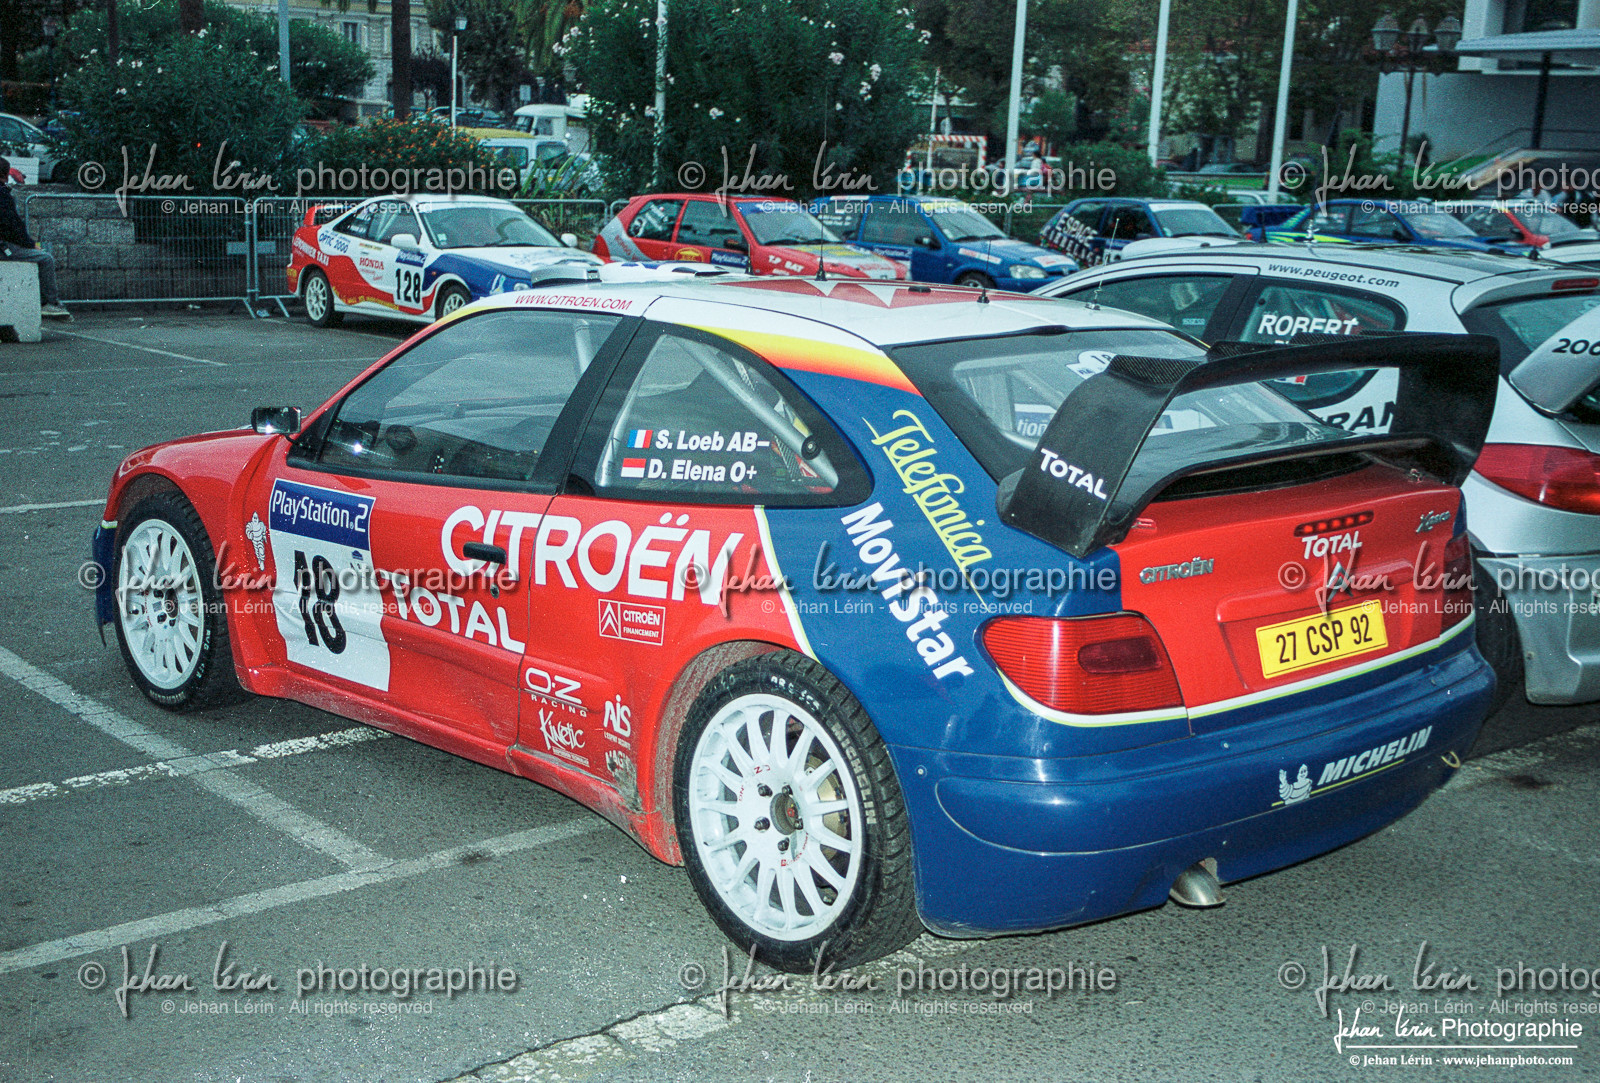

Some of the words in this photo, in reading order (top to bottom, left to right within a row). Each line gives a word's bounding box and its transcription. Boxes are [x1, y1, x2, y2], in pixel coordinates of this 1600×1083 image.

[1055, 212, 1098, 248] ESPACE
[333, 237, 349, 254] 2000
[359, 257, 385, 271] HONDA
[1268, 263, 1400, 288] www.peugeot.com
[395, 267, 421, 304] 128
[515, 295, 633, 310] WWW.CITROEN.COM
[1257, 314, 1359, 336] ROBERT
[655, 429, 674, 450] S.
[676, 430, 725, 451] Loeb
[647, 458, 667, 479] D.
[671, 459, 727, 482] Elena
[1040, 448, 1108, 500] TOTAL
[441, 505, 745, 606] CITROËN
[1301, 531, 1363, 560] TOTAL
[1139, 556, 1215, 585] CITROËN
[293, 549, 347, 655] 18
[379, 569, 526, 654] TOTAL
[622, 609, 661, 626] CITROËN
[622, 626, 660, 639] FINANCEMENT
[1275, 631, 1298, 664] 27
[1305, 618, 1344, 656] CSP
[1350, 613, 1373, 646] 92
[531, 693, 588, 718] RACING
[1317, 725, 1433, 786] MICHELIN
